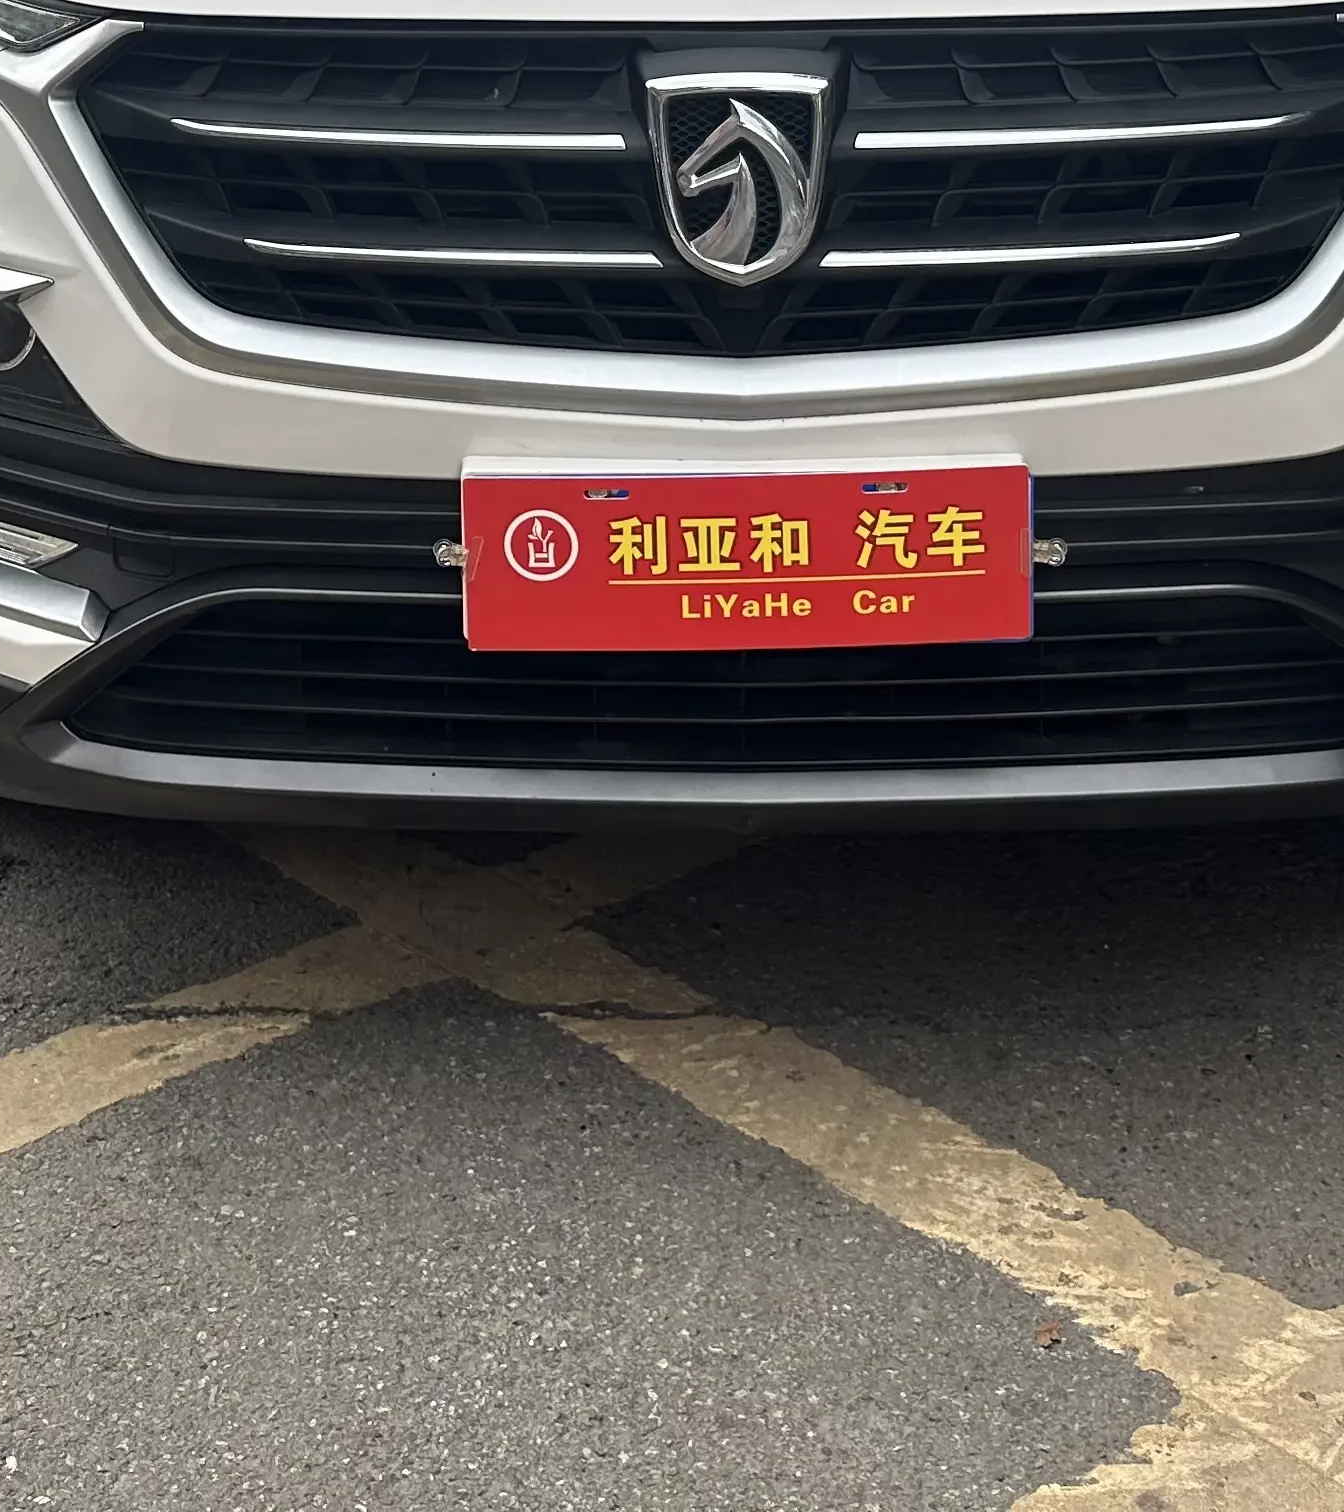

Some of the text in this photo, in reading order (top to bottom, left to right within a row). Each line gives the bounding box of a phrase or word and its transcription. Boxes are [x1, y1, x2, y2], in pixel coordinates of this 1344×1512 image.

[608, 505, 987, 576] 利亚和 汽车
[680, 589, 916, 620] LiYaHe Car
